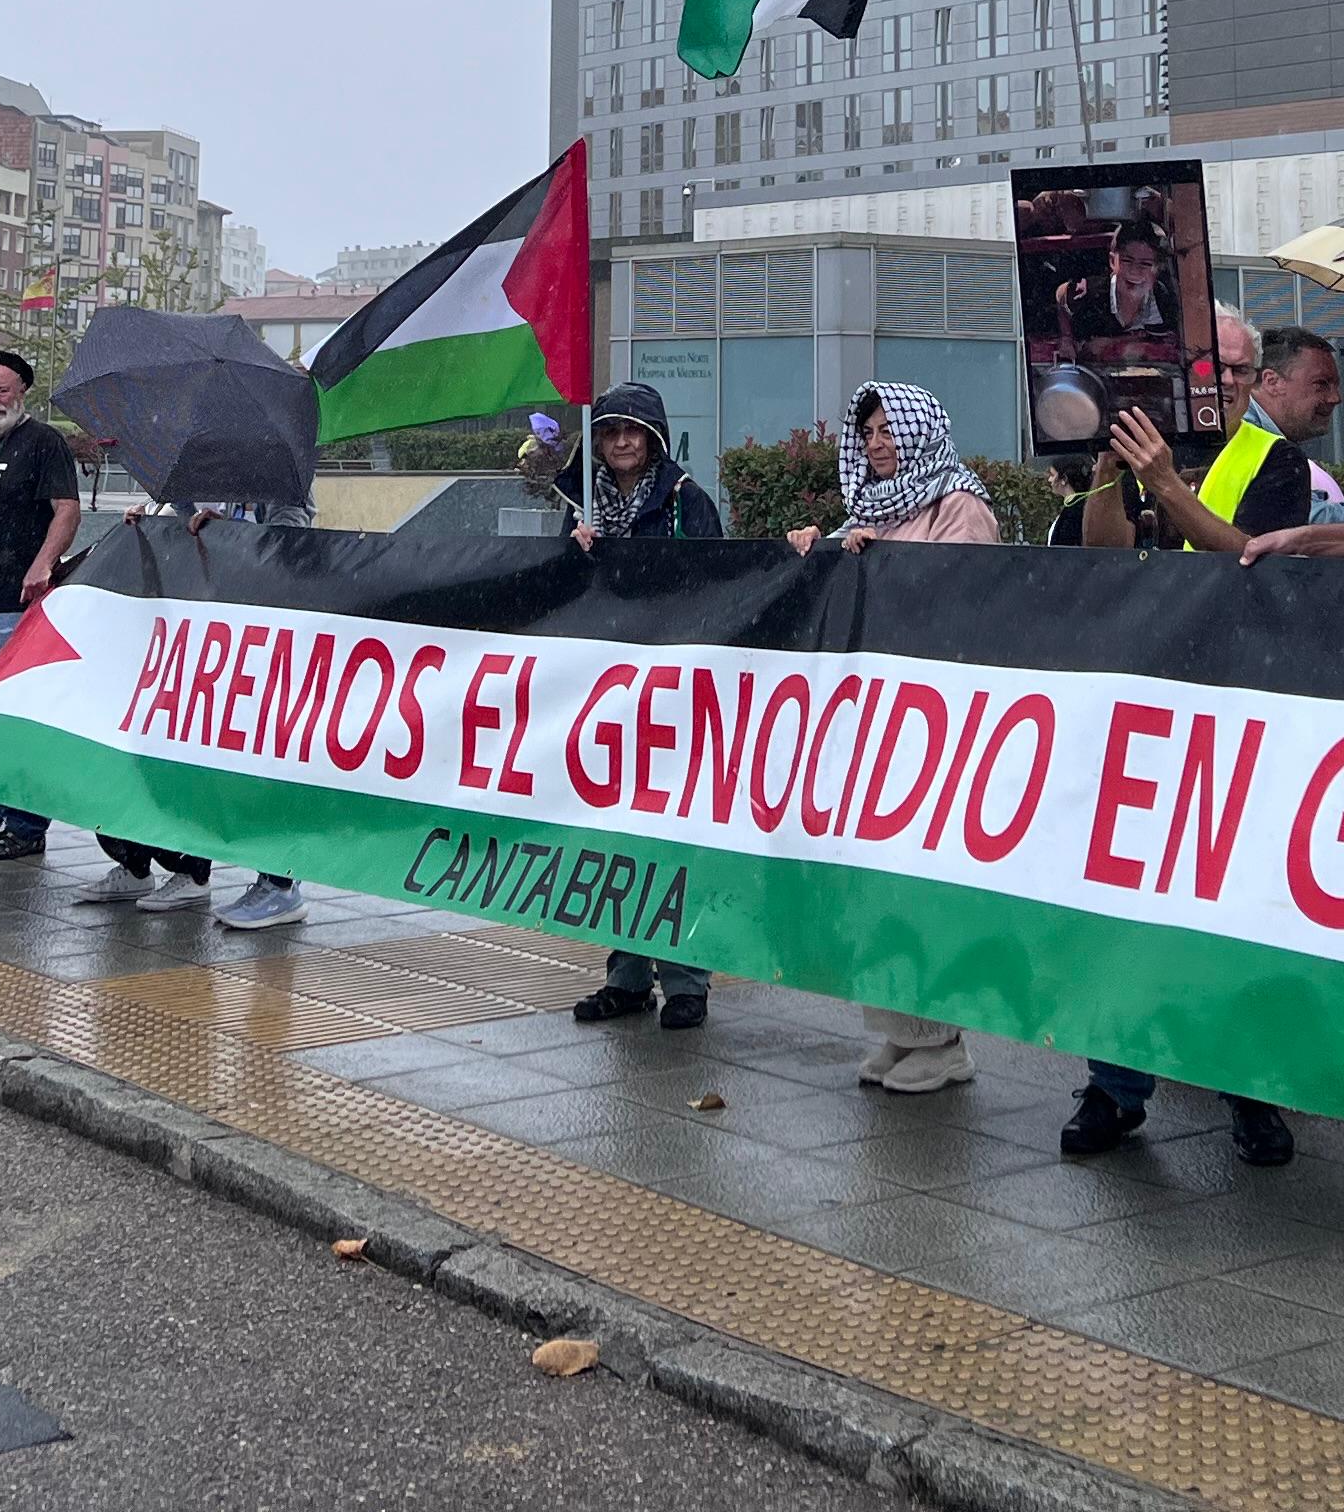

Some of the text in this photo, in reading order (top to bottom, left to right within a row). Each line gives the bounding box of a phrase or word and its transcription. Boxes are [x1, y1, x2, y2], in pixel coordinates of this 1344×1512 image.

[121, 622, 445, 781] PAREMOS
[459, 654, 535, 796] EL
[565, 663, 1056, 863] GENOCIDIO
[1085, 702, 1266, 901] EN
[404, 827, 687, 946] CANTABRIA
